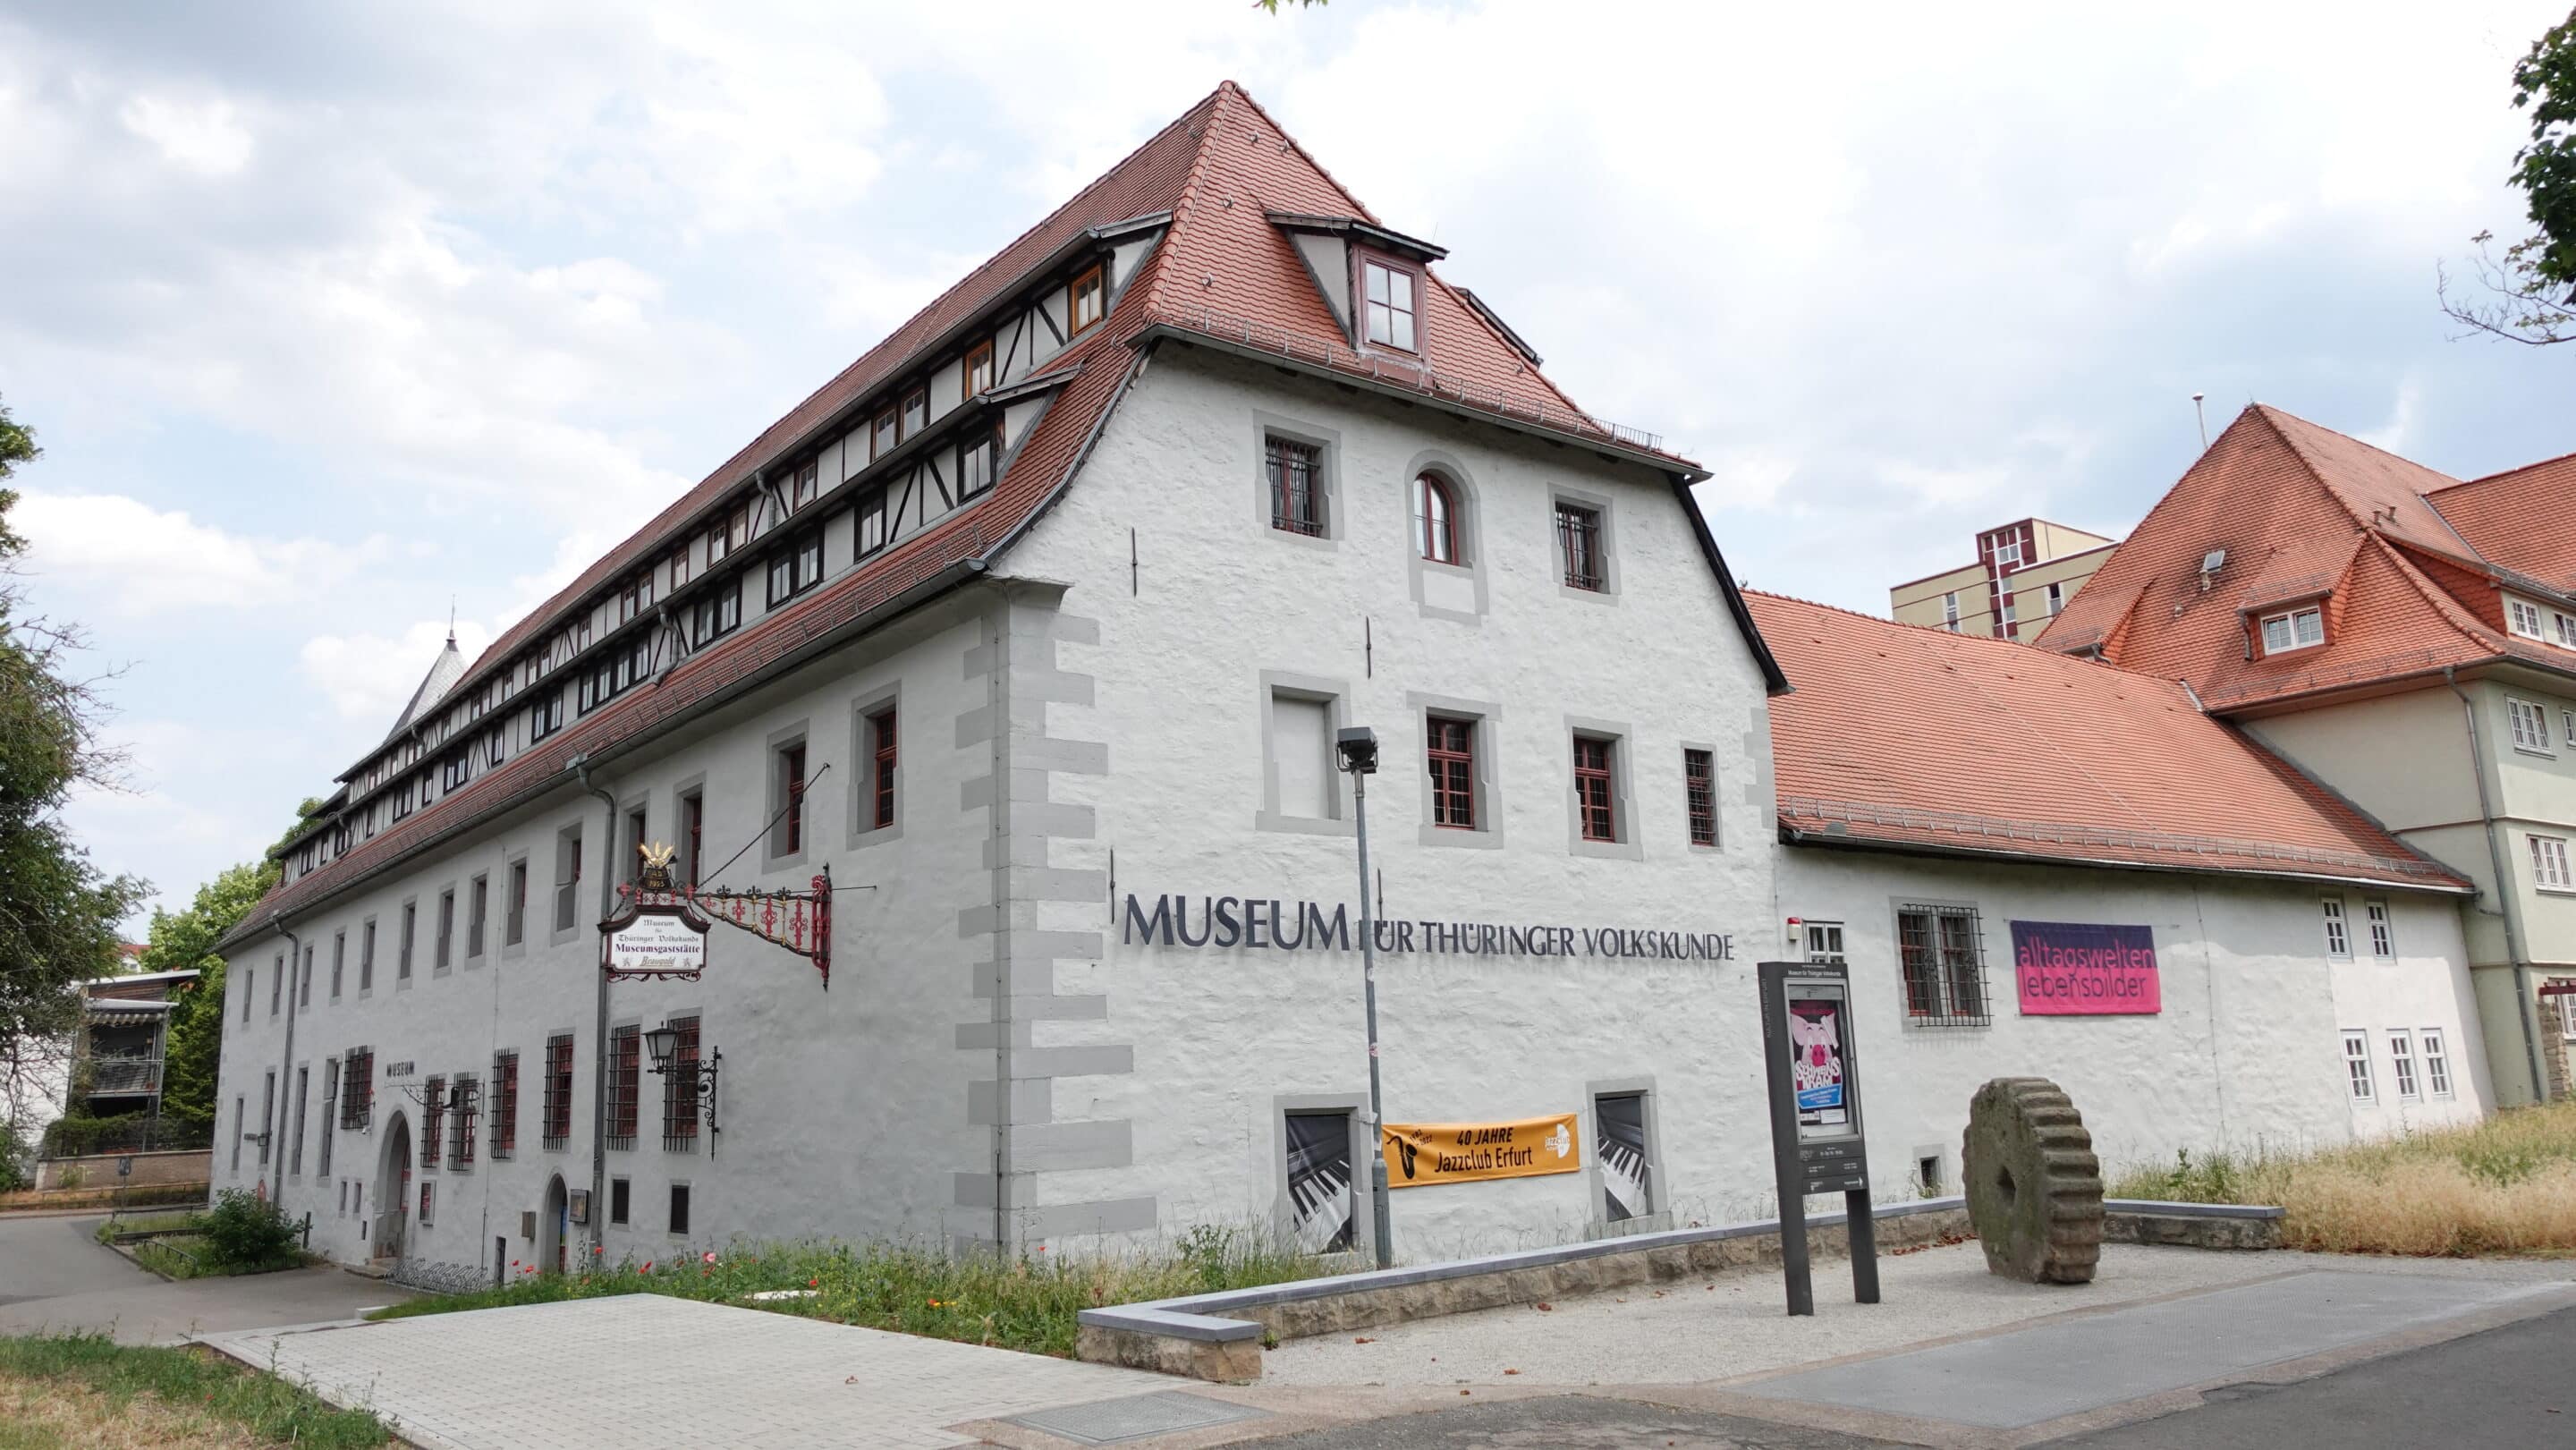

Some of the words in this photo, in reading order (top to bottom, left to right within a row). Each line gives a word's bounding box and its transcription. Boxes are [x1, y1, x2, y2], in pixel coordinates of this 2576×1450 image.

[1123, 894, 1350, 951] MUSEUM
[1419, 921, 1576, 956] THÜRINGER
[1582, 928, 1734, 961] VOLKSKUNDE
[615, 944, 701, 954] Museumsgaststätte
[2019, 937, 2155, 976] alltagswelten
[2021, 966, 2147, 997] lebensbilder
[386, 1061, 414, 1077] MUSEUM
[1457, 1130, 1472, 1146] 40
[1474, 1127, 1513, 1145] JAHRE
[1434, 1149, 1492, 1174] Jazzclub
[1496, 1146, 1533, 1168] Erfurt
